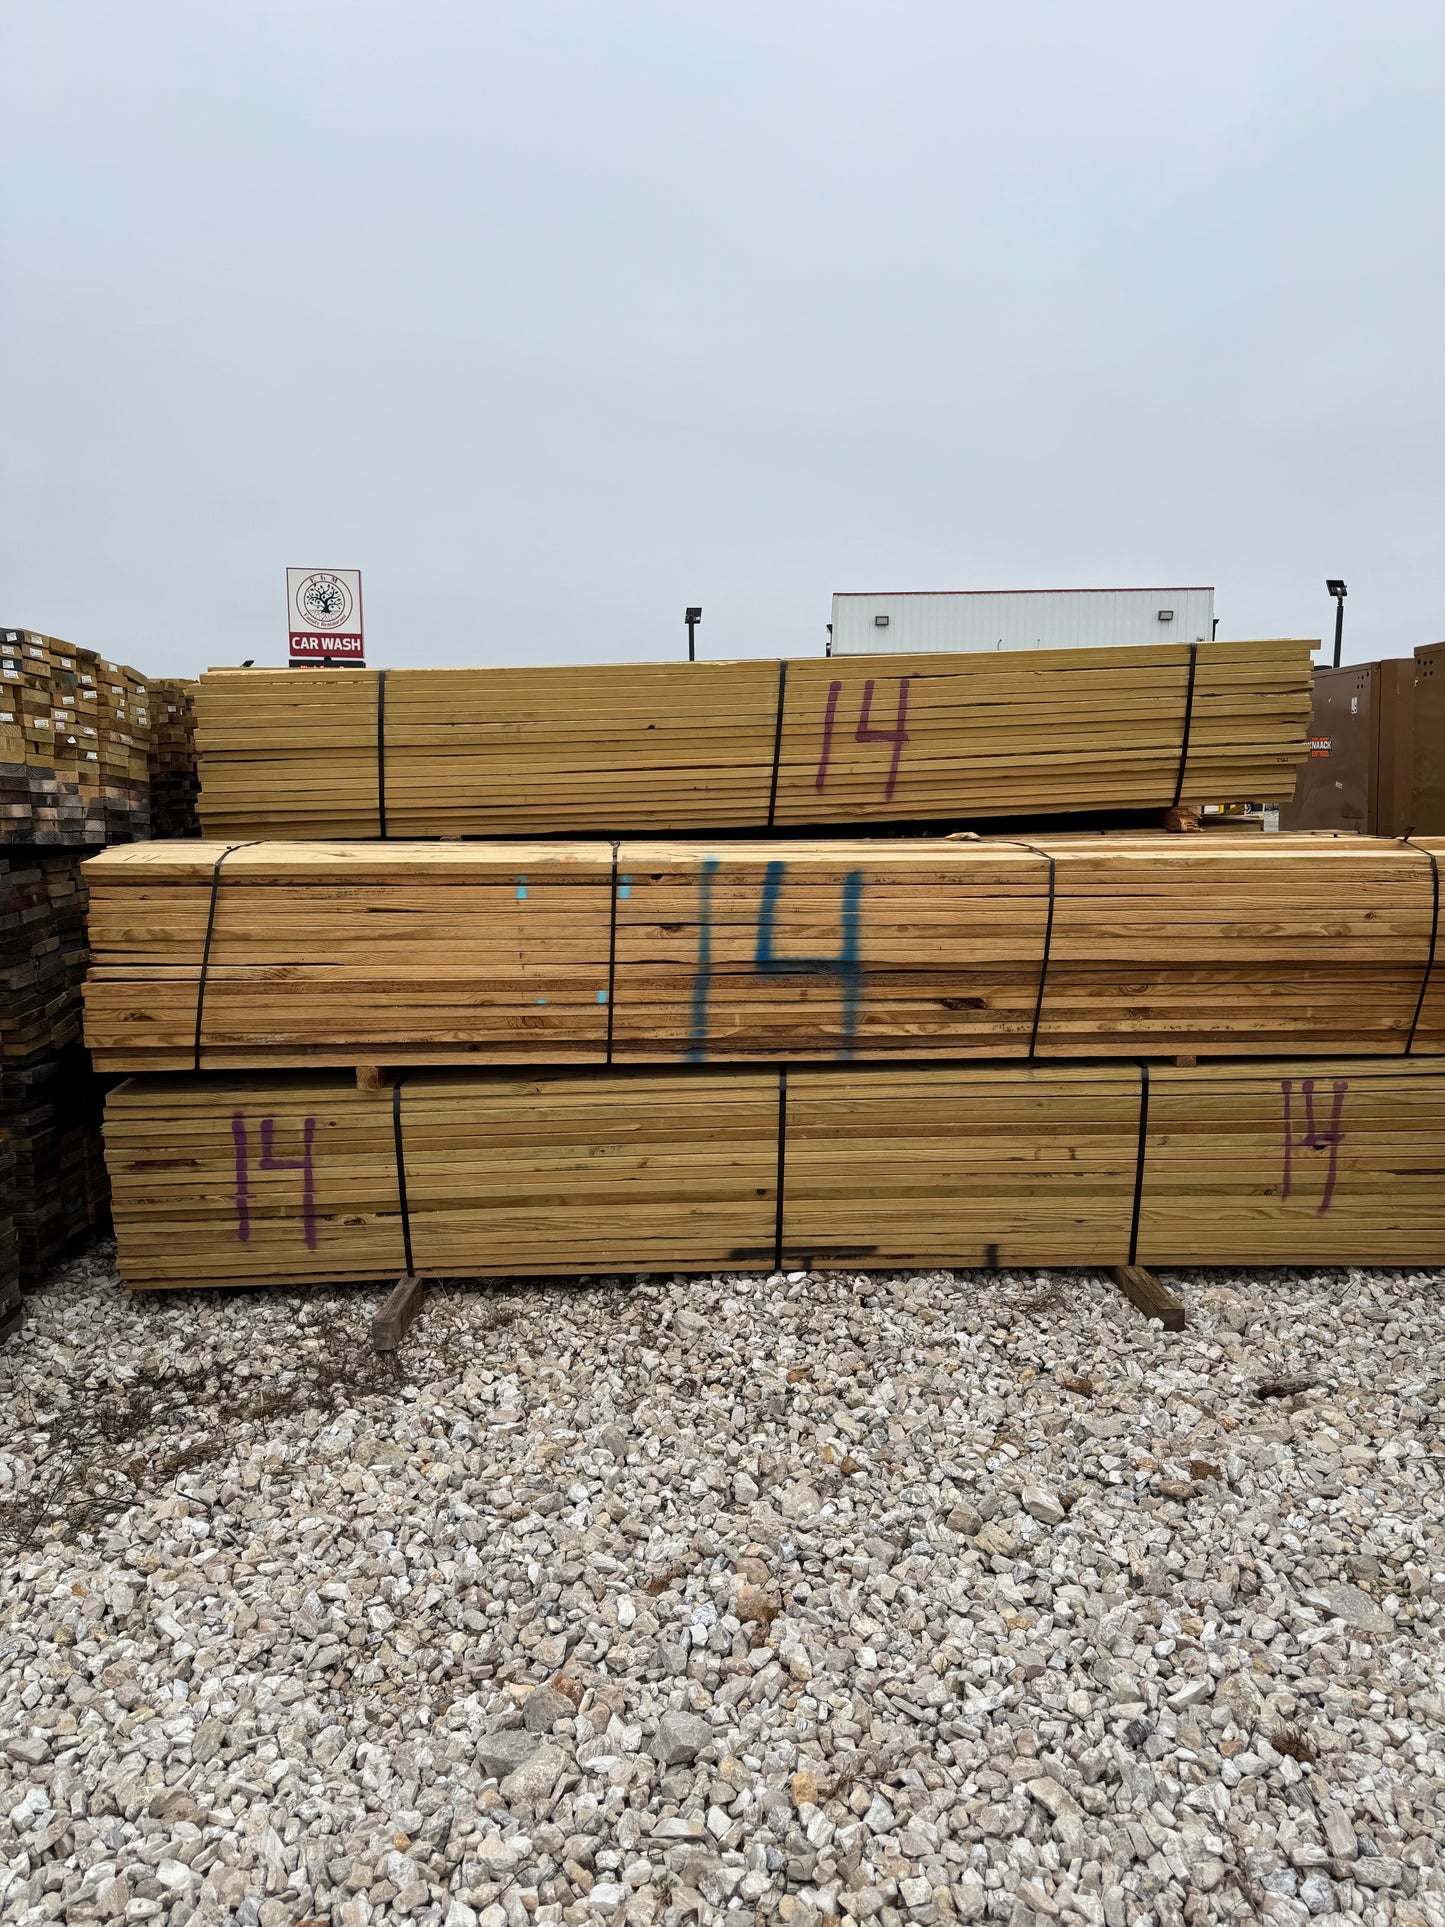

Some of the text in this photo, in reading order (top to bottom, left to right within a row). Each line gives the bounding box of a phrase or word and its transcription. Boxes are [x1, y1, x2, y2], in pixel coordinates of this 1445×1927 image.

[292, 637, 360, 651] CAR WASH
[815, 678, 909, 801] 14
[685, 858, 862, 1061] 14
[232, 1112, 316, 1250] 14
[1282, 1080, 1348, 1217] 14
